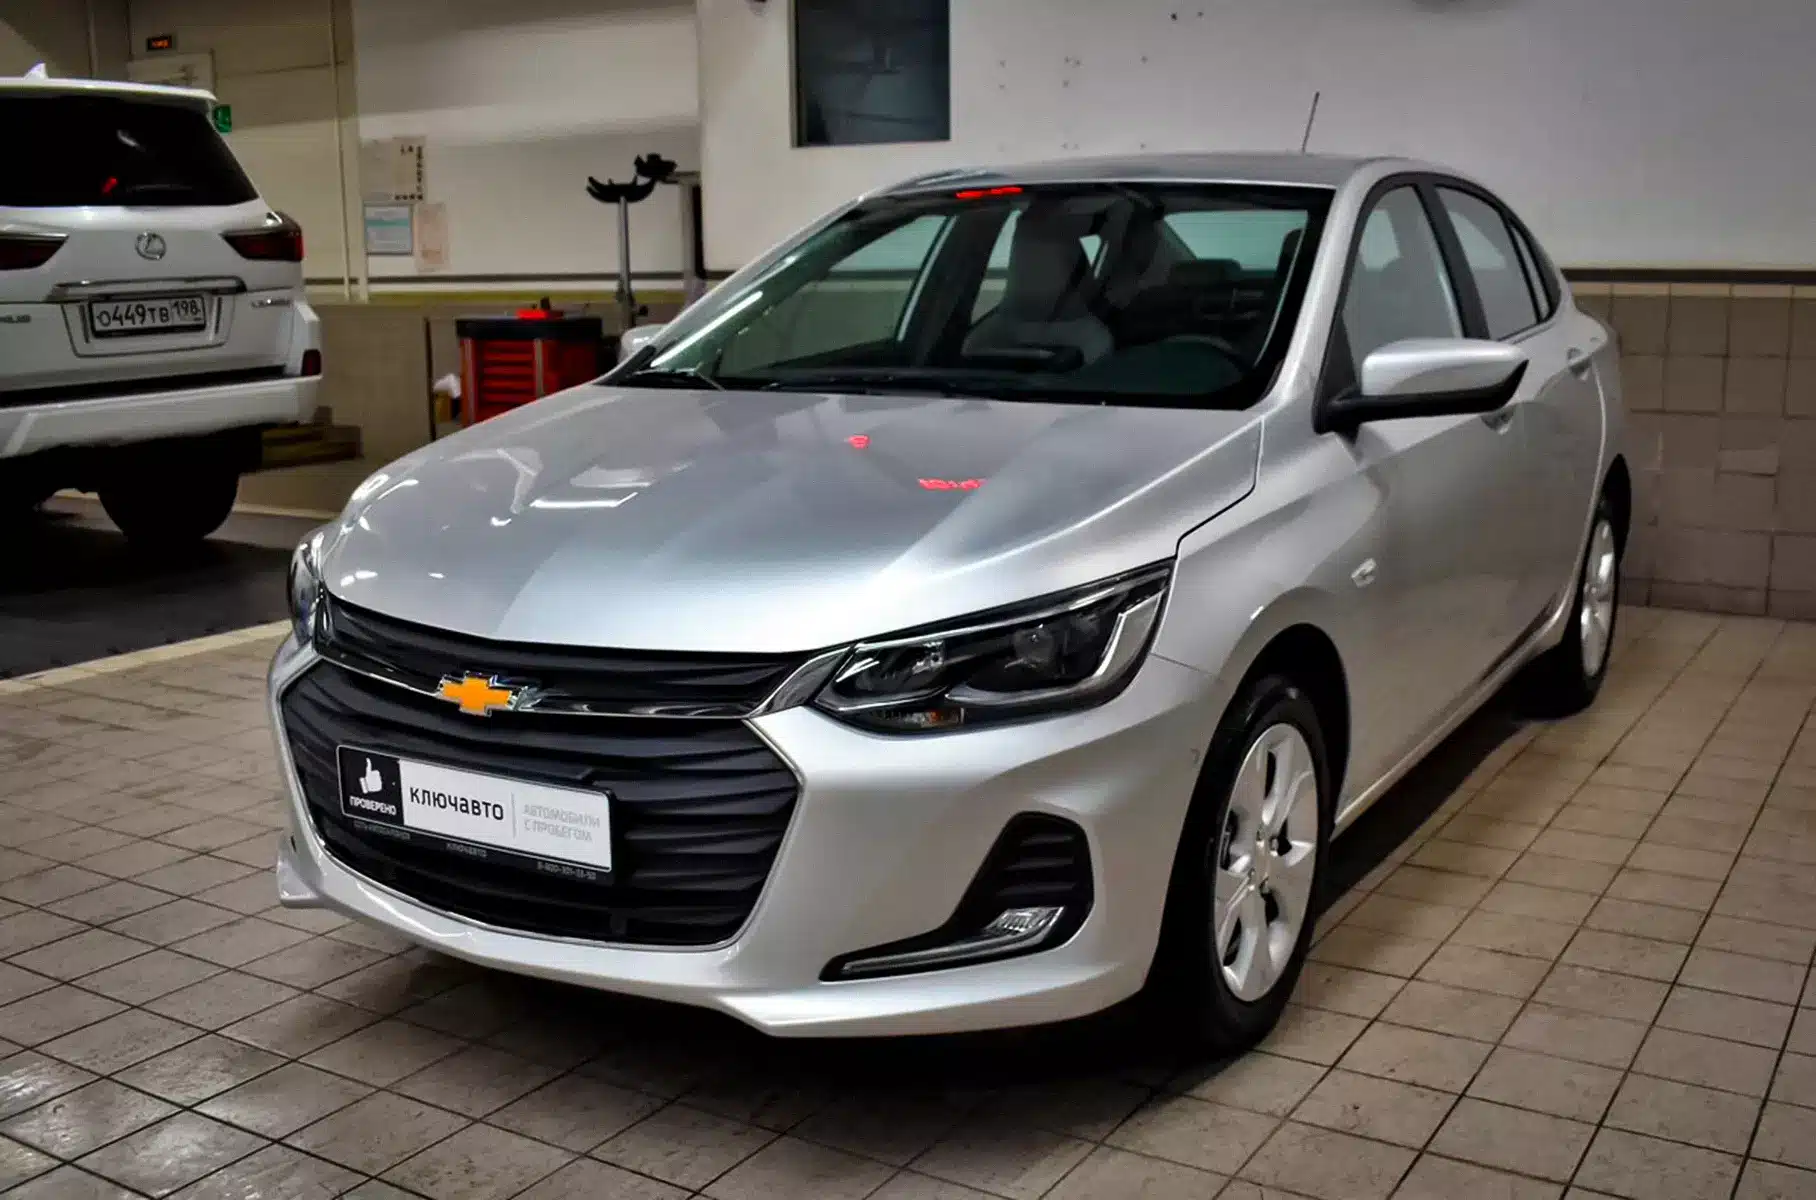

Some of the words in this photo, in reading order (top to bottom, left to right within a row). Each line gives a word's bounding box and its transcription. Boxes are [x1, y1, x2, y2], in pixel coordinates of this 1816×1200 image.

[172, 299, 198, 316] 198
[349, 795, 397, 816] ПРОВЕРЕНО
[409, 787, 505, 821] ключавто
[522, 803, 601, 828] АВТОМОБИЛИ
[532, 820, 593, 841] ПРОБЕГОМ
